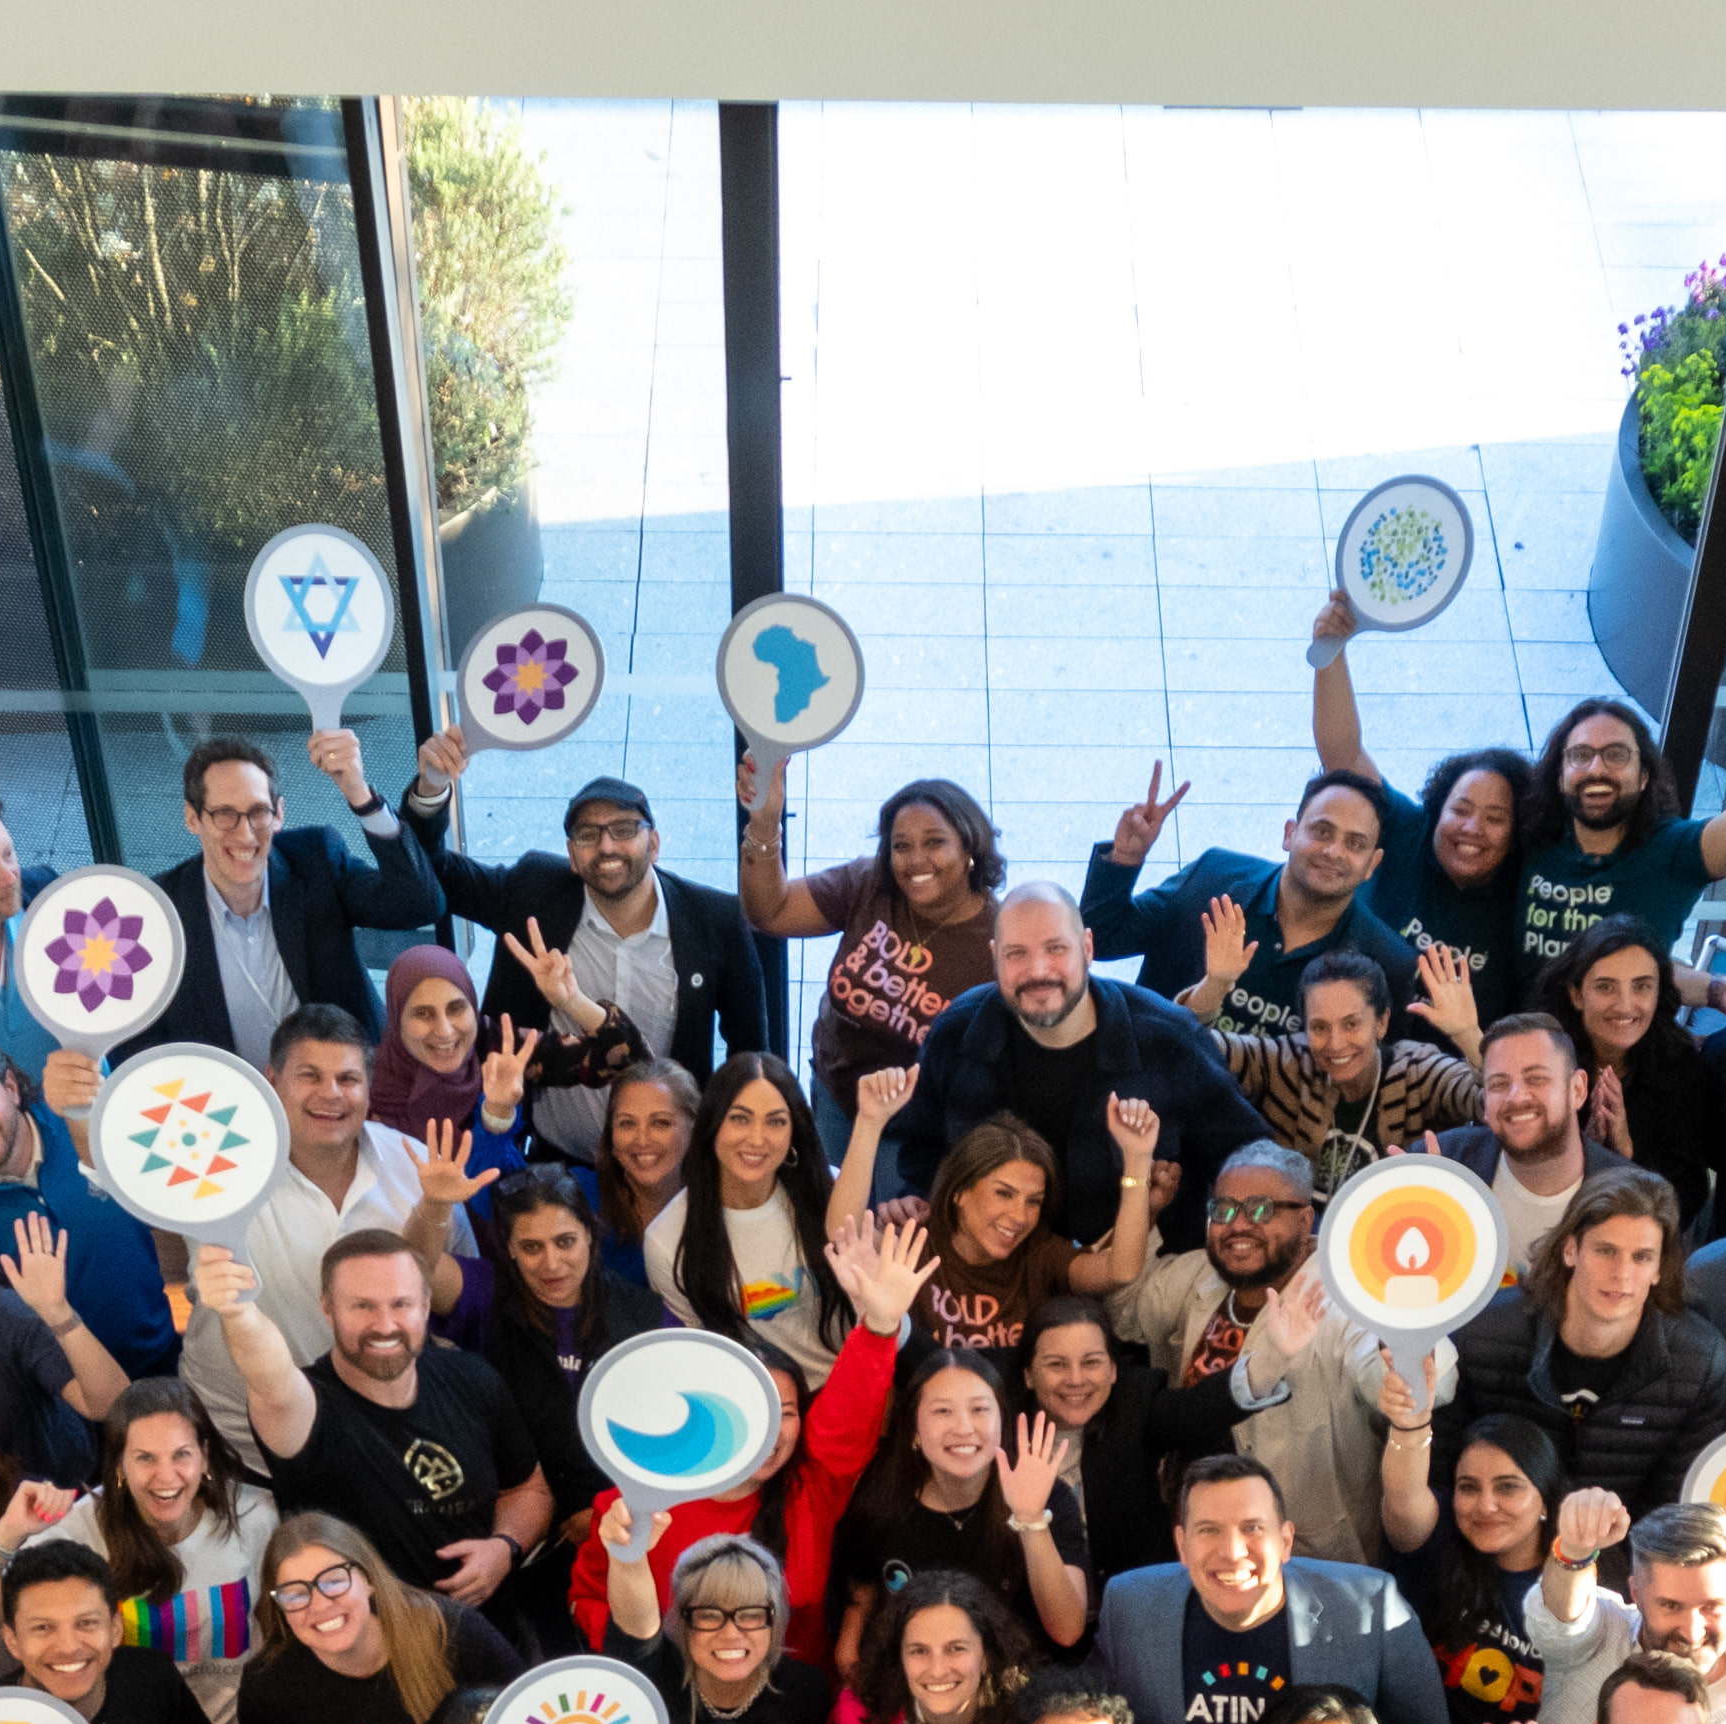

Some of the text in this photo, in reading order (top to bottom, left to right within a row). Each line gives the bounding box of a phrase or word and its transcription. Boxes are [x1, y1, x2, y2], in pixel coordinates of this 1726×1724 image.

[1528, 874, 1613, 906] People
[1526, 902, 1560, 930] for
[863, 919, 934, 975] BOLD
[1231, 987, 1301, 1033] eople
